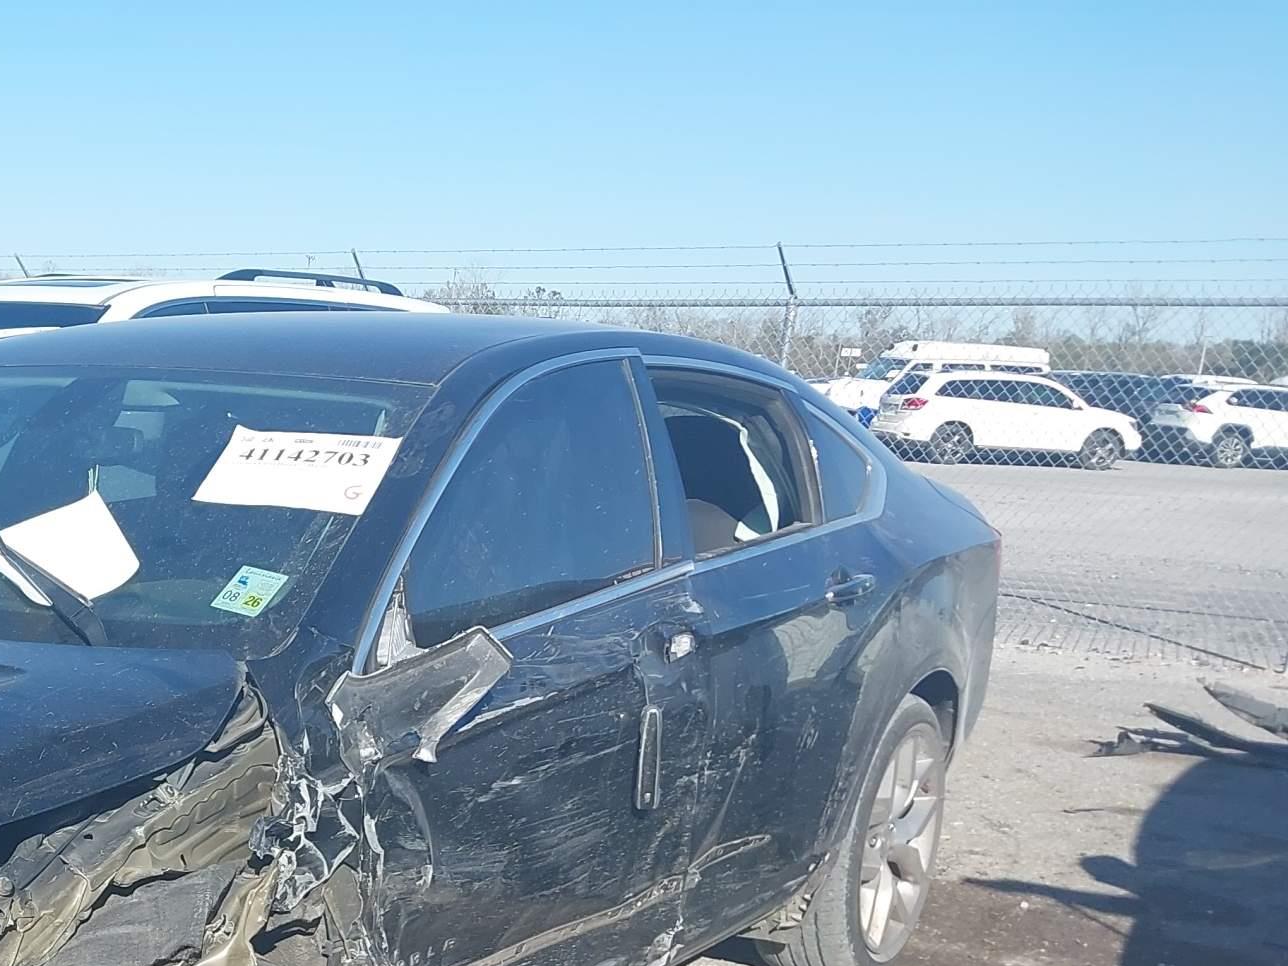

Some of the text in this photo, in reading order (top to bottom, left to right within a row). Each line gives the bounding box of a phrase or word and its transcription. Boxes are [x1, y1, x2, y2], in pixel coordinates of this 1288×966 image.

[239, 447, 371, 468] 41142703
[343, 484, 363, 501] G
[222, 590, 263, 608] 08 26
